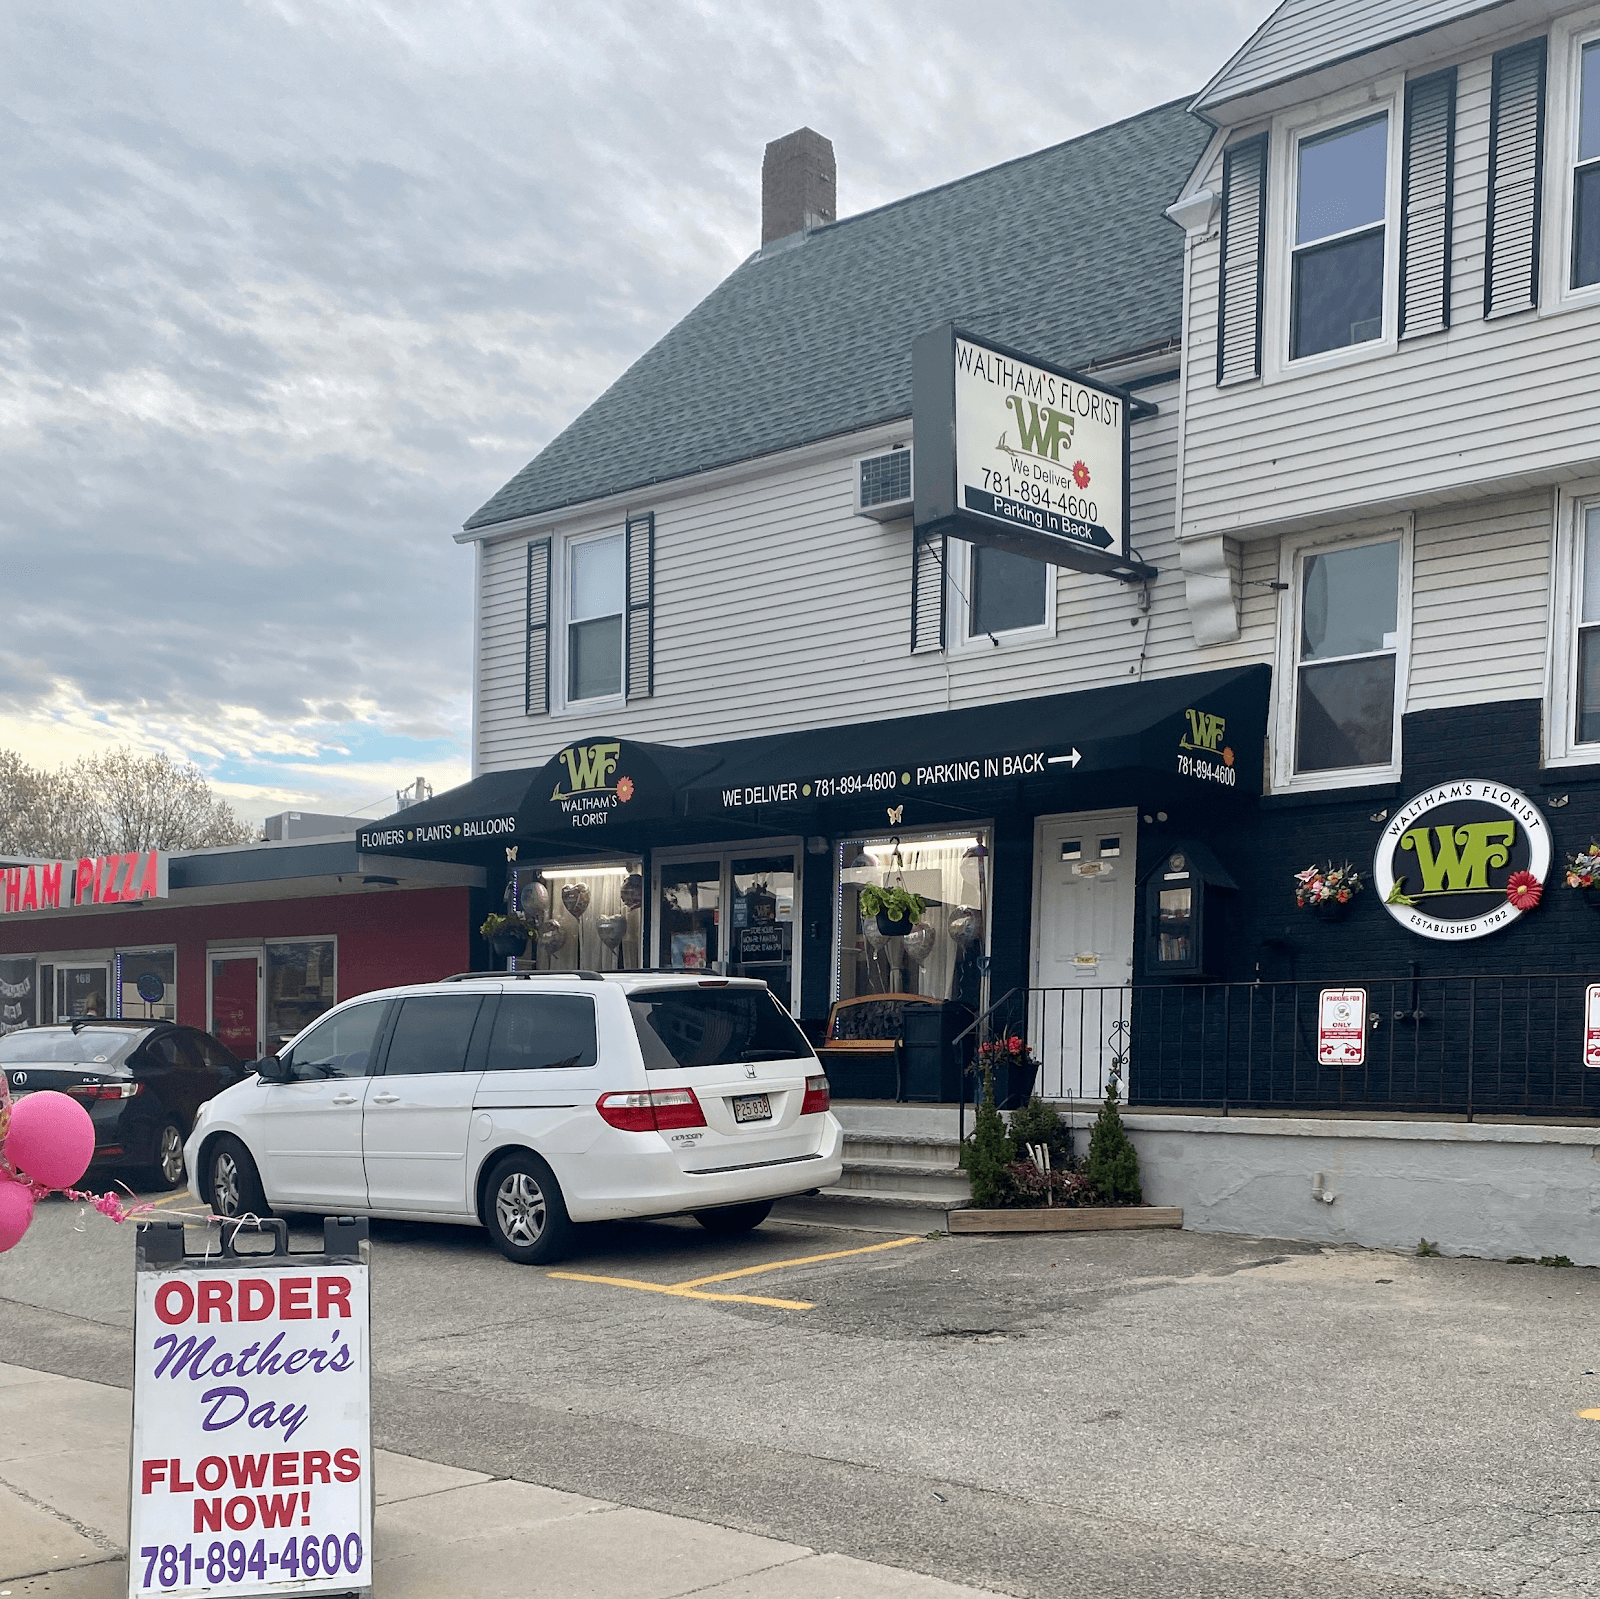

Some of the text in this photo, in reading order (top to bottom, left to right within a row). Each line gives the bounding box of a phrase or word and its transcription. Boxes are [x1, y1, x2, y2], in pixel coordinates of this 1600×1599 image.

[956, 341, 1120, 428] WALTHAM'S FLORIST
[1005, 394, 1075, 462] WF
[981, 466, 1098, 523] 781-894-4600
[1011, 456, 1072, 490] We Deliver
[993, 495, 1093, 541] Parking In Back
[1185, 708, 1226, 750] WF
[559, 742, 621, 791] WF
[722, 752, 1045, 808] WE DELIVER 781-894-4600 PARKING IN BACK
[1177, 754, 1236, 787] 781-894-4600
[561, 794, 618, 813] WALTHAM'S
[572, 811, 608, 828] FLORIST
[1388, 781, 1541, 837] WALTHAM'S FLORIST
[361, 816, 516, 848] FLOWERS PLANTS BALLOONS
[1400, 819, 1516, 893] WF
[75, 848, 158, 906] PIZZA
[1410, 910, 1508, 934] ESTABLISHED 1982
[671, 1132, 705, 1142] ODYSSEY
[154, 1276, 352, 1325] ORDER
[153, 1329, 355, 1382] Mother's
[200, 1385, 309, 1443] Day
[141, 1448, 361, 1495] FLOWERS
[192, 1491, 311, 1534] NOW!
[140, 1532, 363, 1589] 781-894-4600
